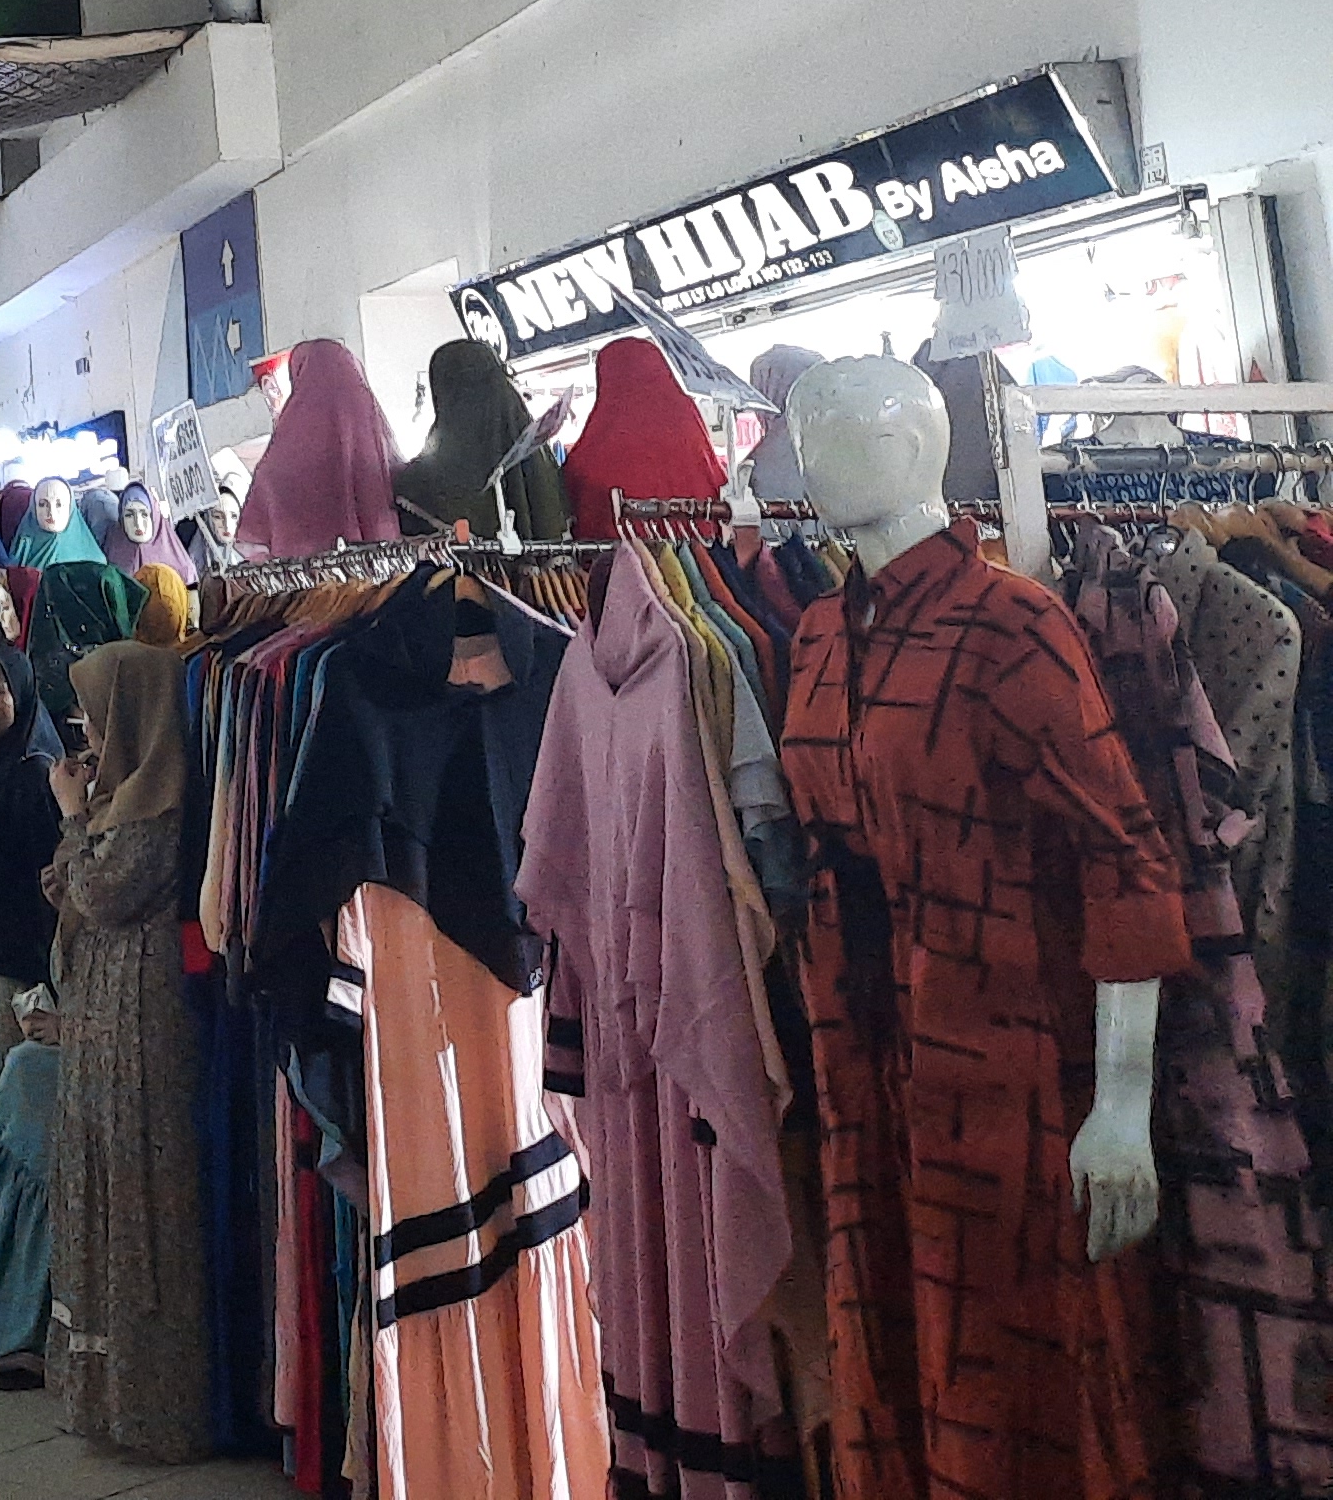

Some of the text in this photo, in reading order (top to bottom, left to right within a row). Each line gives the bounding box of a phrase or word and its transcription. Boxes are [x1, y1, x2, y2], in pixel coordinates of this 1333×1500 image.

[495, 237, 635, 341] NEW
[634, 160, 877, 292] HIJAB
[874, 177, 934, 223] By
[937, 139, 1065, 203] Aisha
